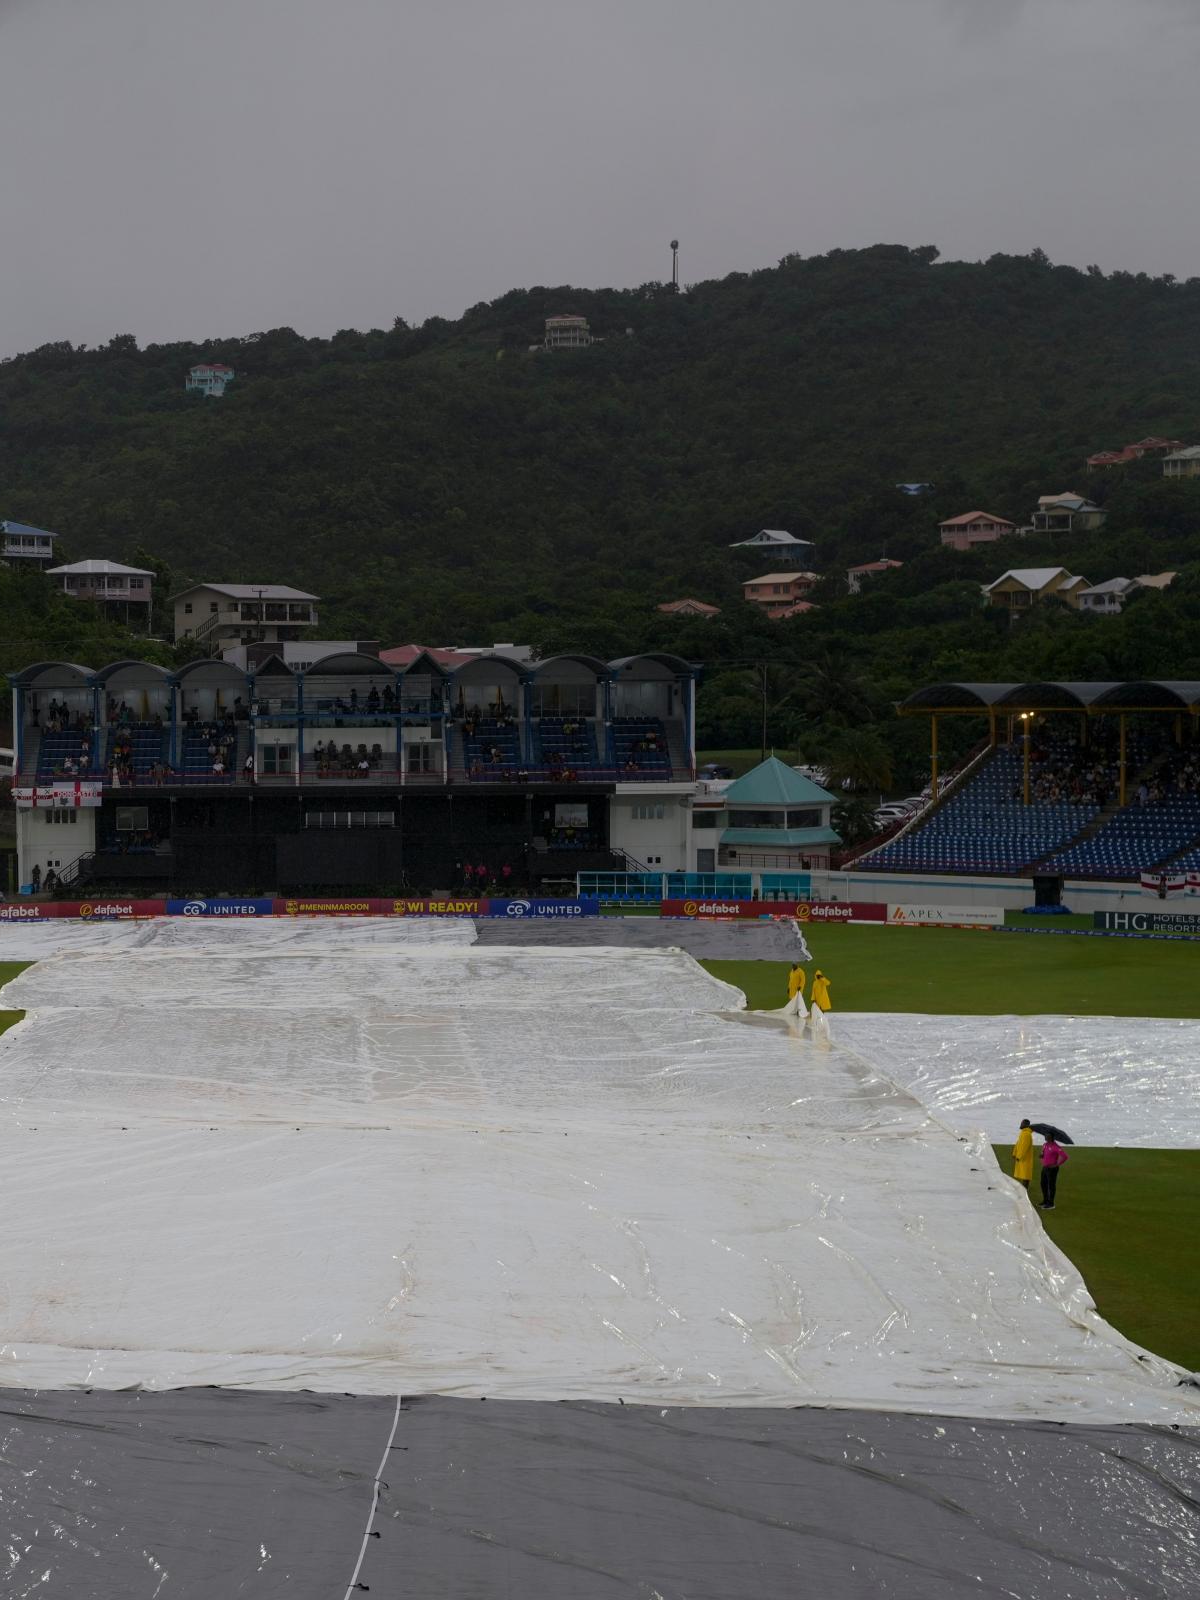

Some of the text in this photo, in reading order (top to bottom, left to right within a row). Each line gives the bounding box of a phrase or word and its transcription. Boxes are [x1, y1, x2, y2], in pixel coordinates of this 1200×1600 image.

[94, 904, 133, 916] dafabet
[214, 906, 256, 914] UNITED
[299, 903, 369, 911] #MENINMAROON
[407, 902, 478, 913] WI READY!
[538, 905, 582, 914] UNITED
[698, 903, 740, 915] dafabet
[811, 905, 853, 917] dafabet
[908, 909, 943, 919] APEX
[1153, 914, 1195, 923] HOTELS
[1105, 912, 1147, 931] IHG
